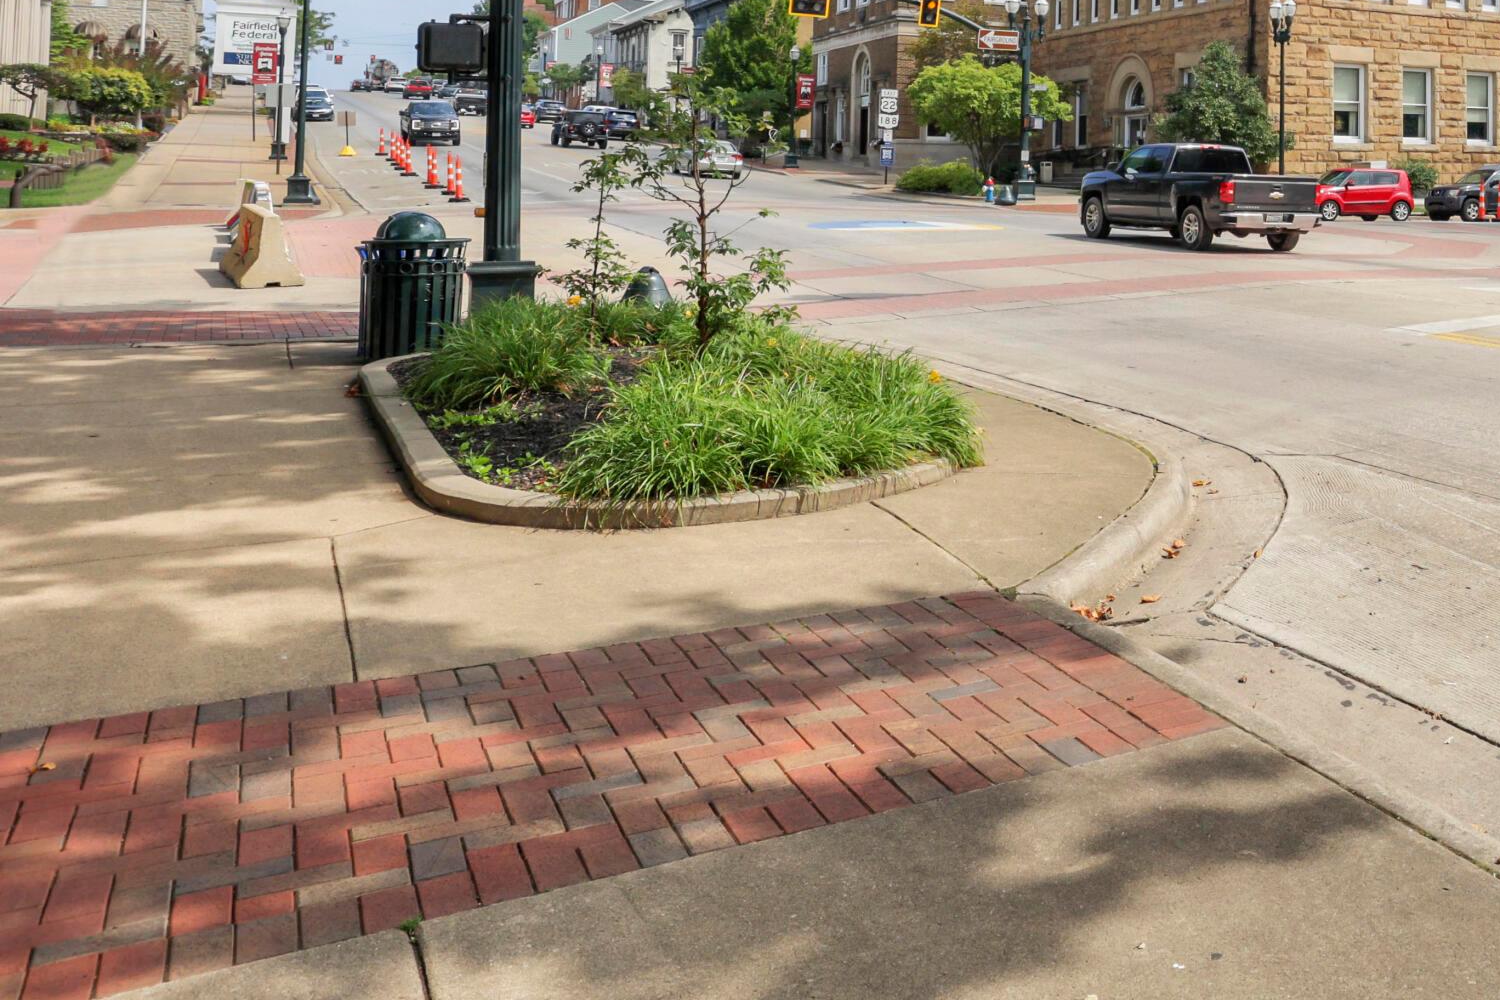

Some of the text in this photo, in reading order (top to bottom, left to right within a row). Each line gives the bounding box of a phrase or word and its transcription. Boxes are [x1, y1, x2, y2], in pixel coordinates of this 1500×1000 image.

[233, 20, 278, 32] Fairfield
[232, 29, 277, 41] Federal
[882, 101, 896, 110] 22
[880, 117, 897, 125] 188
